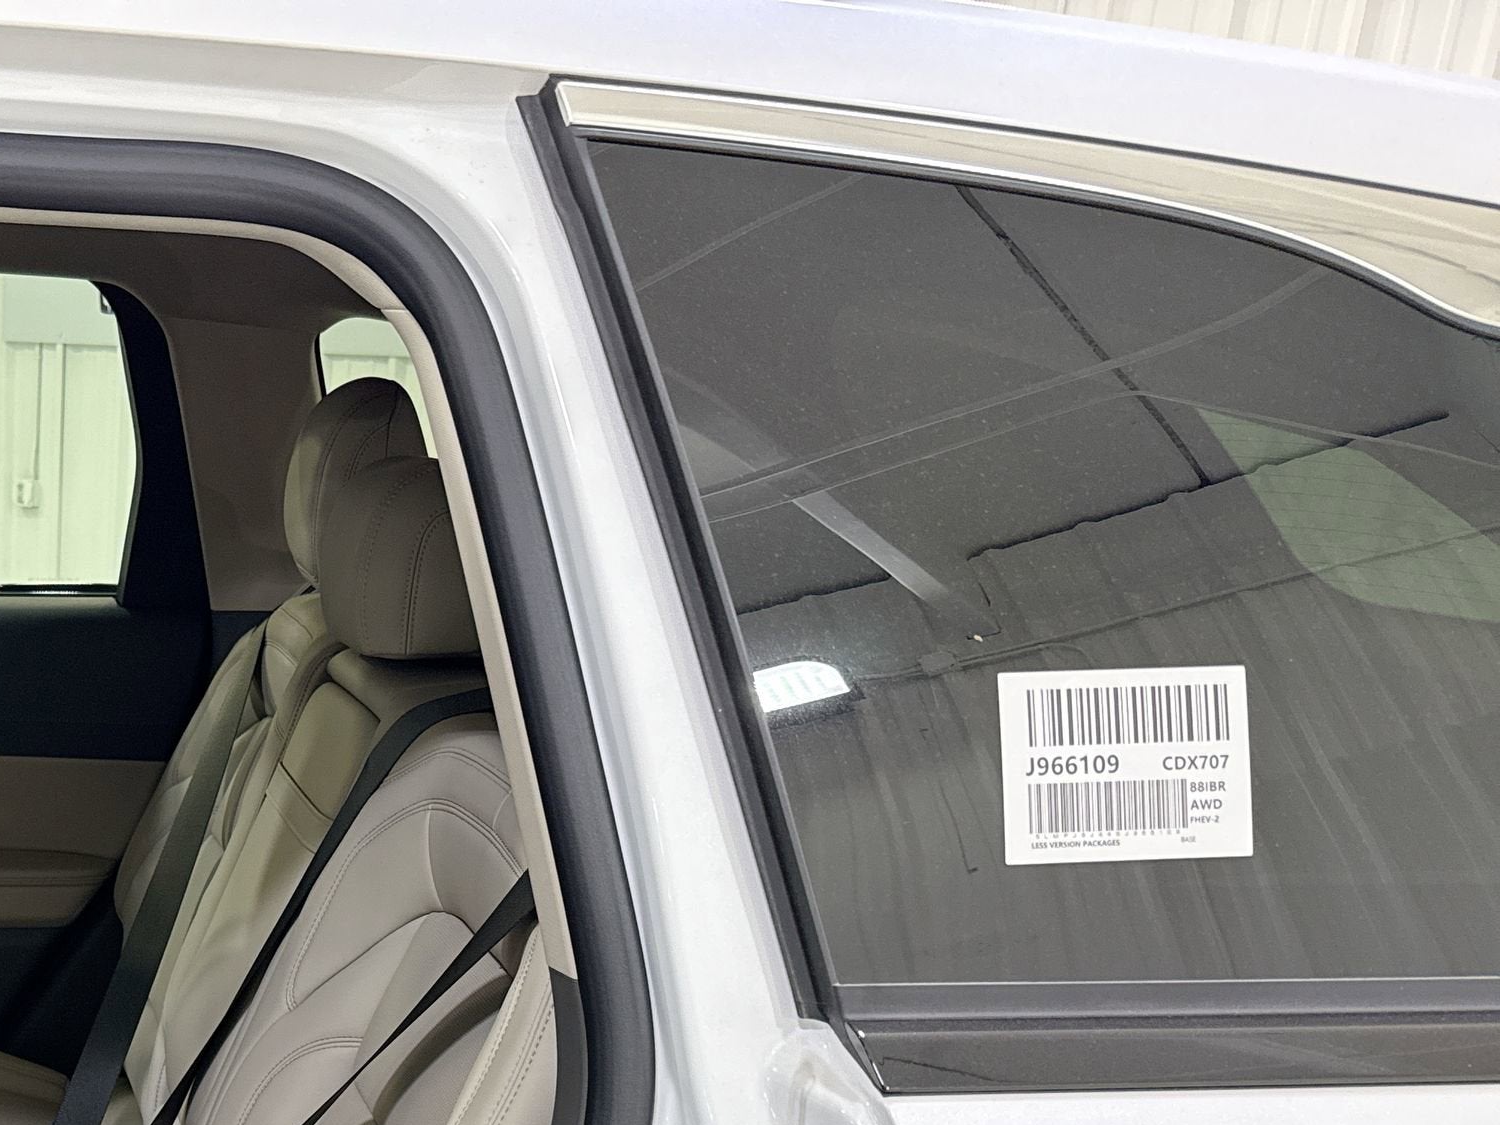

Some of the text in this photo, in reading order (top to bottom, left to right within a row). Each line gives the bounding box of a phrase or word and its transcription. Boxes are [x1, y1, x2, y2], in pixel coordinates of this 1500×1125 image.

[1025, 754, 1230, 776] J966109 CDX707
[1190, 798, 1223, 811] AWD
[1031, 839, 1121, 850] LESS VERSION PACKAGES
